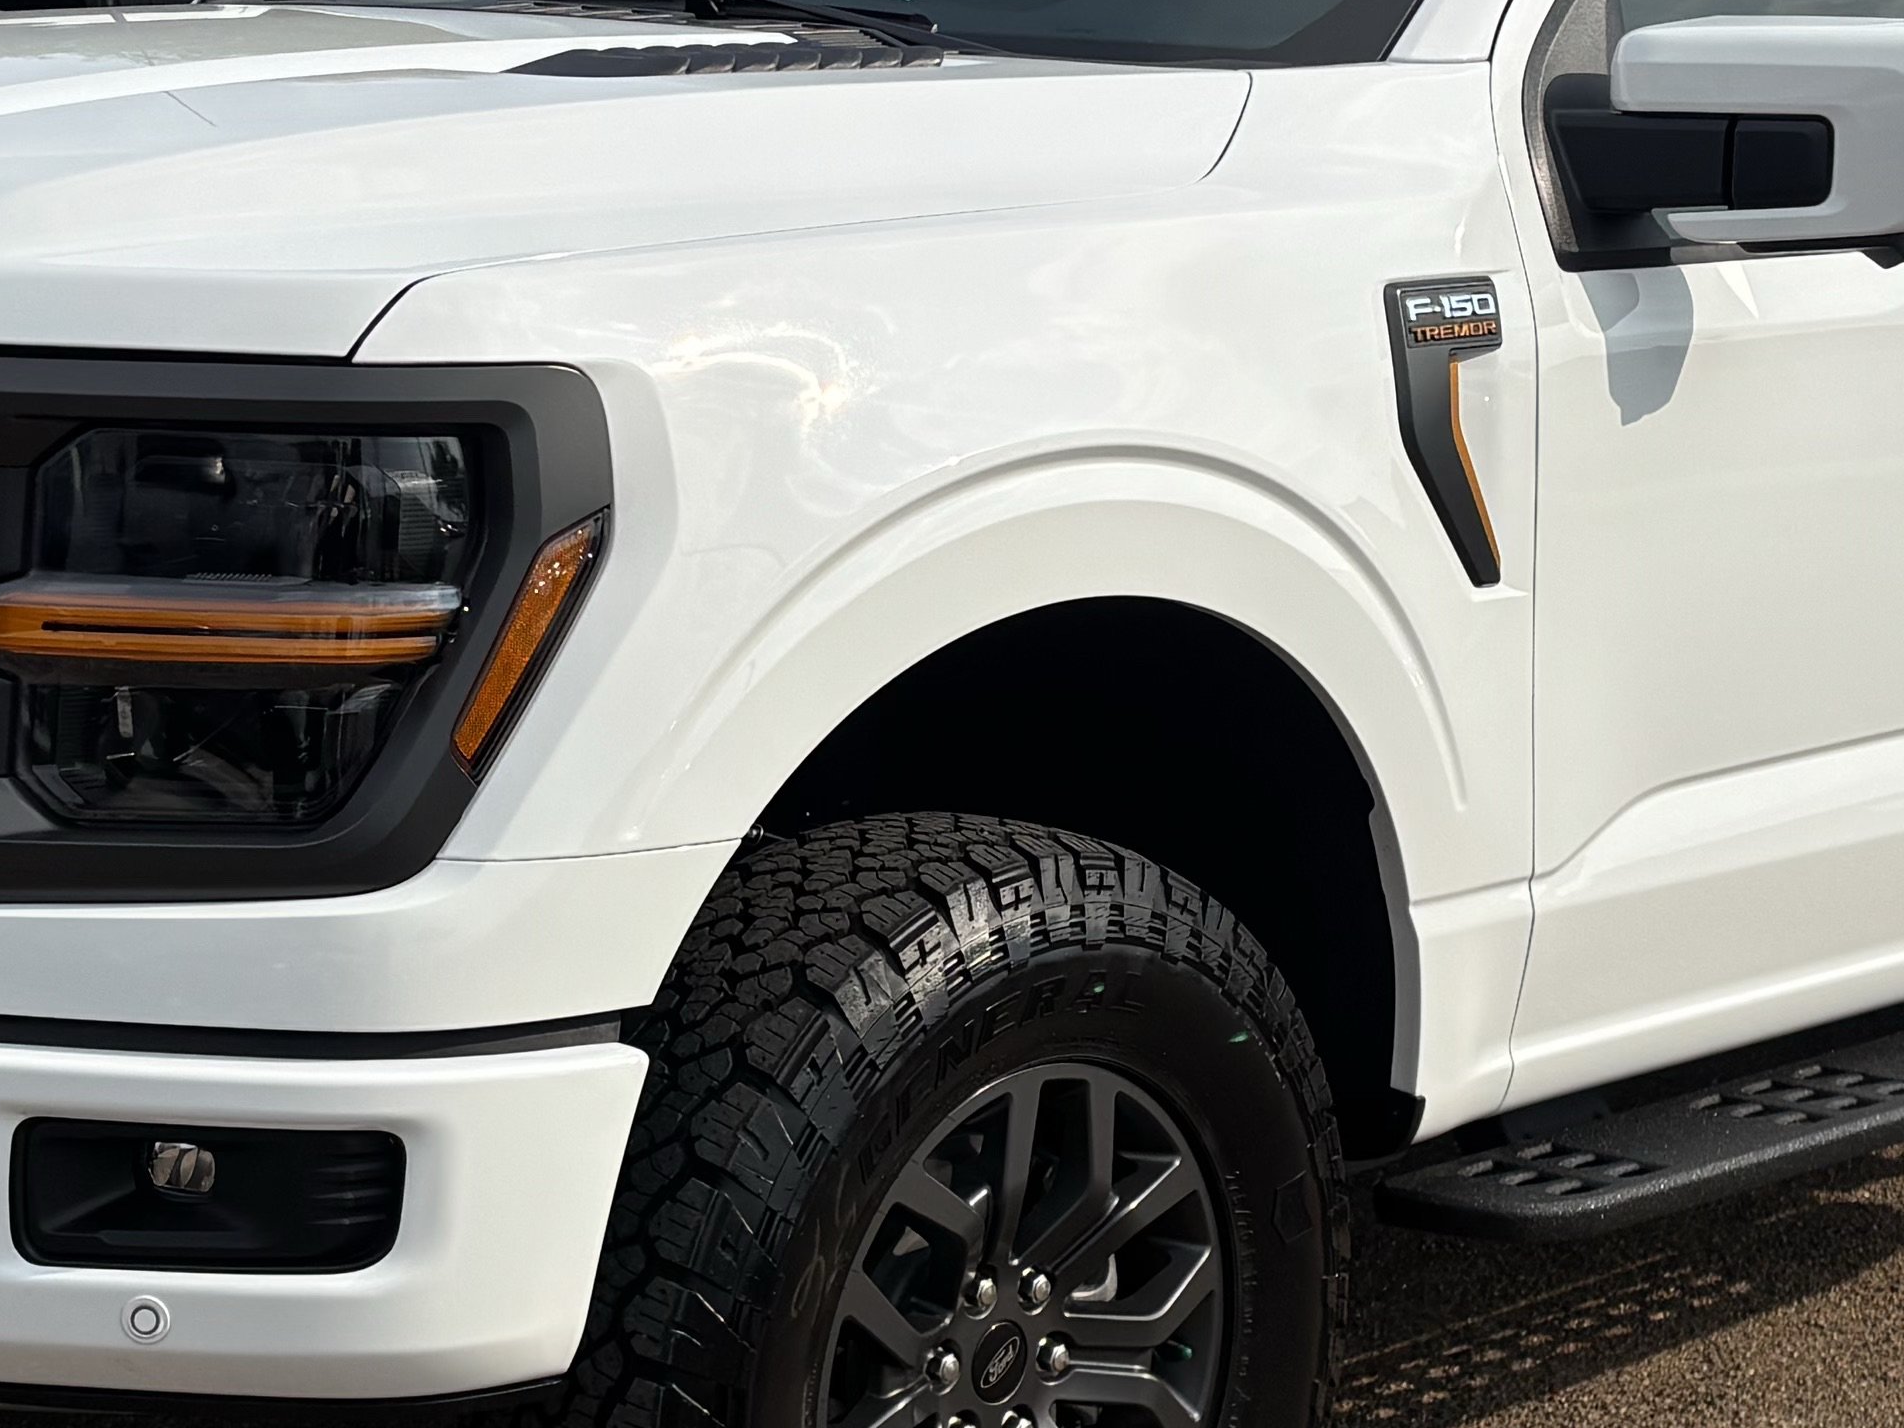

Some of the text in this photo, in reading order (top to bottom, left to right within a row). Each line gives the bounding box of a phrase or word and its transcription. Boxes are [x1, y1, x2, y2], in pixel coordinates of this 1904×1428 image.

[1406, 293, 1497, 321] F-150
[1409, 320, 1497, 342] TREMOR
[988, 1343, 1014, 1383] Ford
